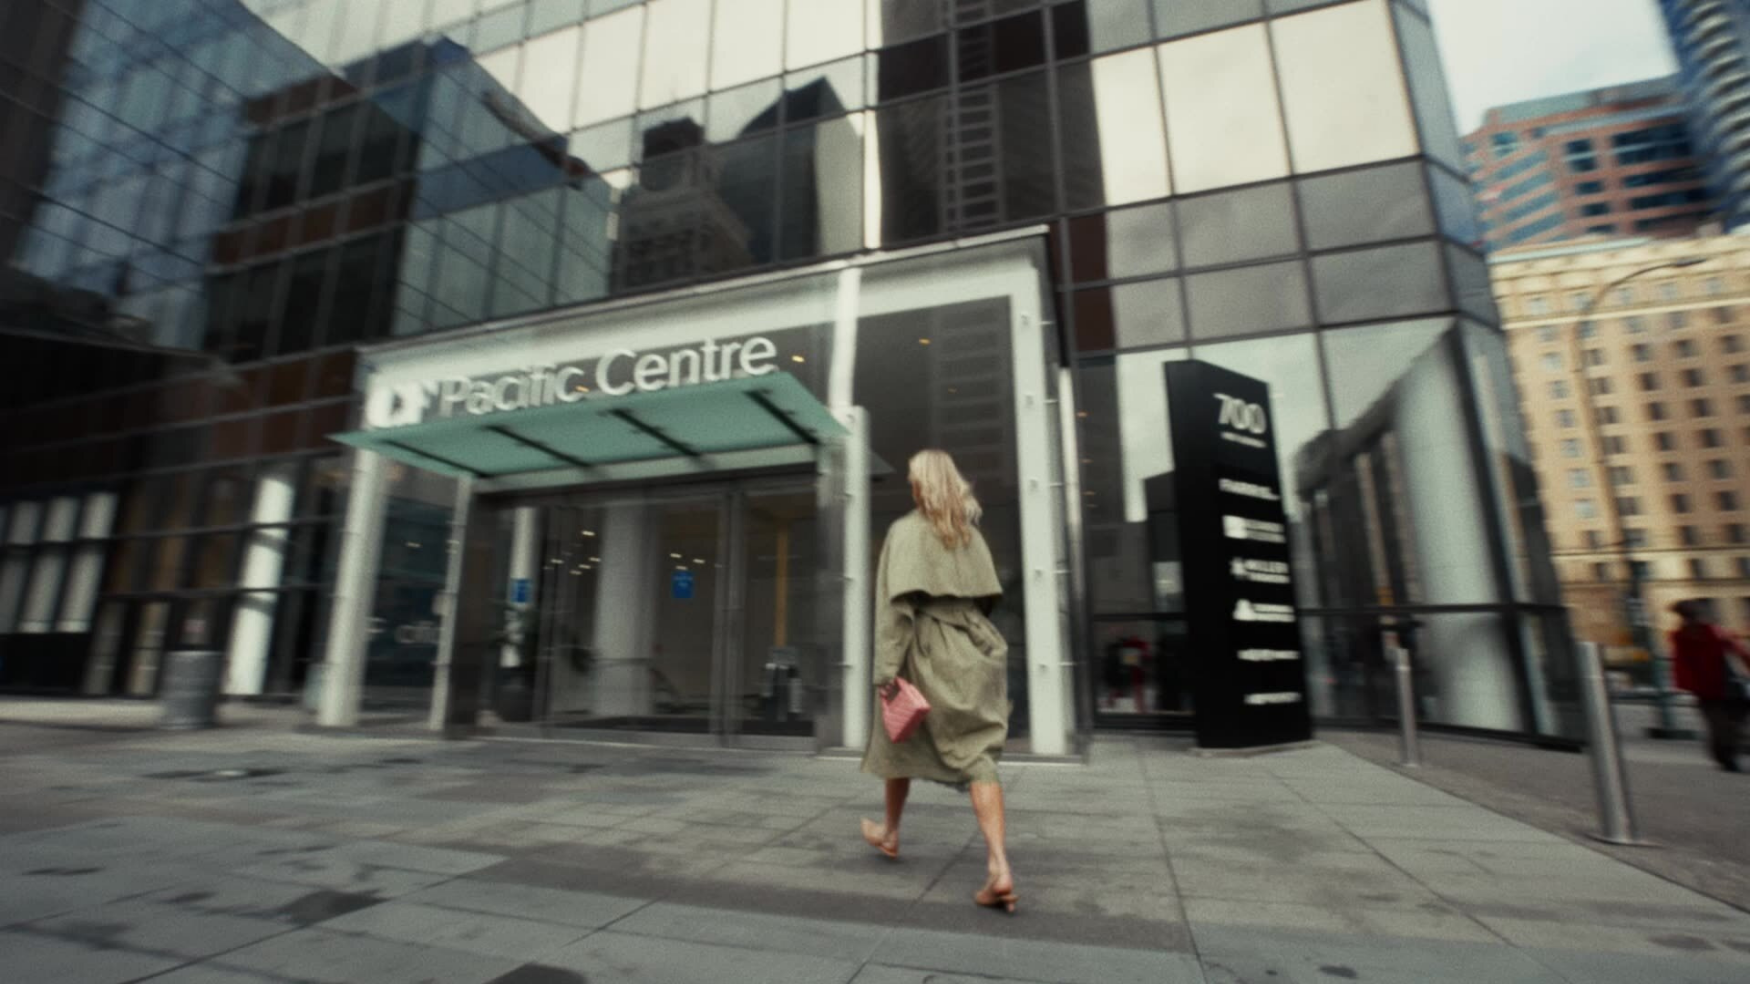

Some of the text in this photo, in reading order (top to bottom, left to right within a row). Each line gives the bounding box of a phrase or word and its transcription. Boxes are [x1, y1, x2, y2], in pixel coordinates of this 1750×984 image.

[438, 365, 586, 417] Pacific
[596, 336, 777, 395] Centre
[1212, 392, 1267, 434] 700
